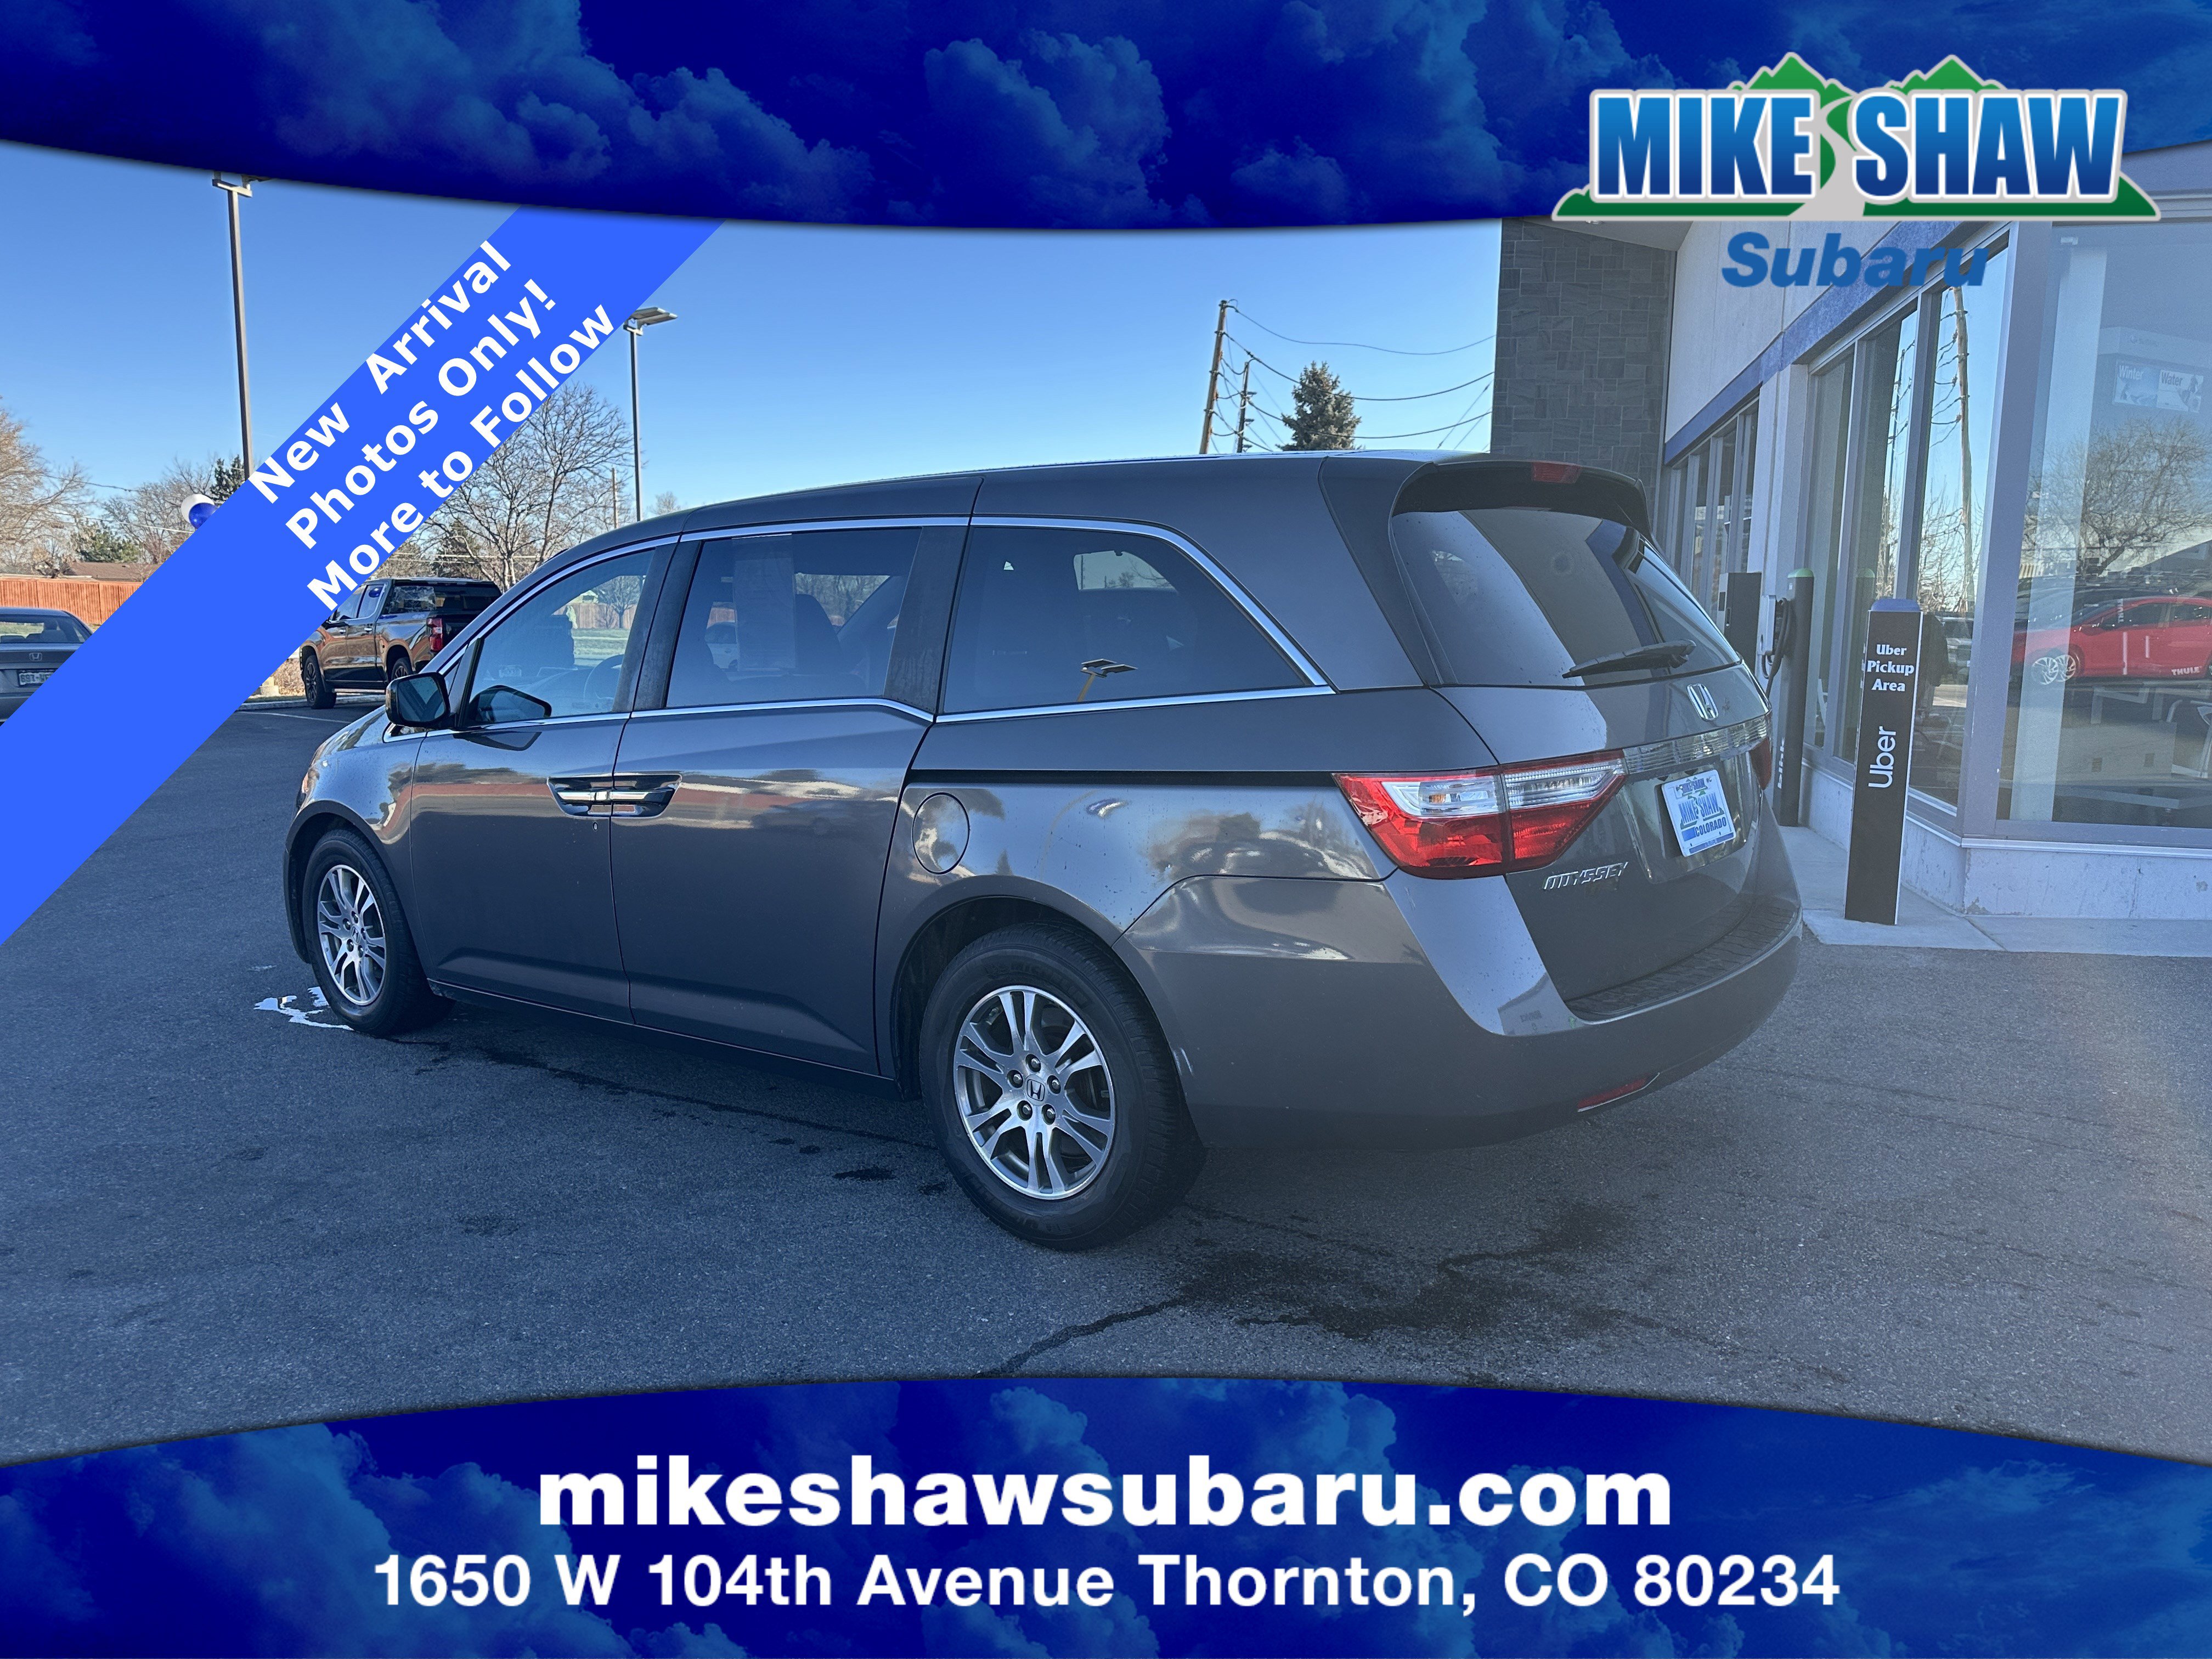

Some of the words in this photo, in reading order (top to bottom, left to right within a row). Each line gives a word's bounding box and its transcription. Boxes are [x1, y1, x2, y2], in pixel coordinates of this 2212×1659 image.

[2119, 365, 2144, 380] Winter
[2161, 371, 2183, 386] Water
[1876, 644, 1906, 656] Uber
[1867, 660, 1915, 676] Pickup
[2171, 666, 2200, 675] THULE
[1871, 679, 1905, 691] Area
[1868, 726, 1897, 788] Uber
[1678, 799, 1699, 823] MIKE
[1698, 792, 1719, 817] SHAW
[1695, 817, 1727, 837] COLORADO
[1543, 861, 1629, 890] ODYSSEY
